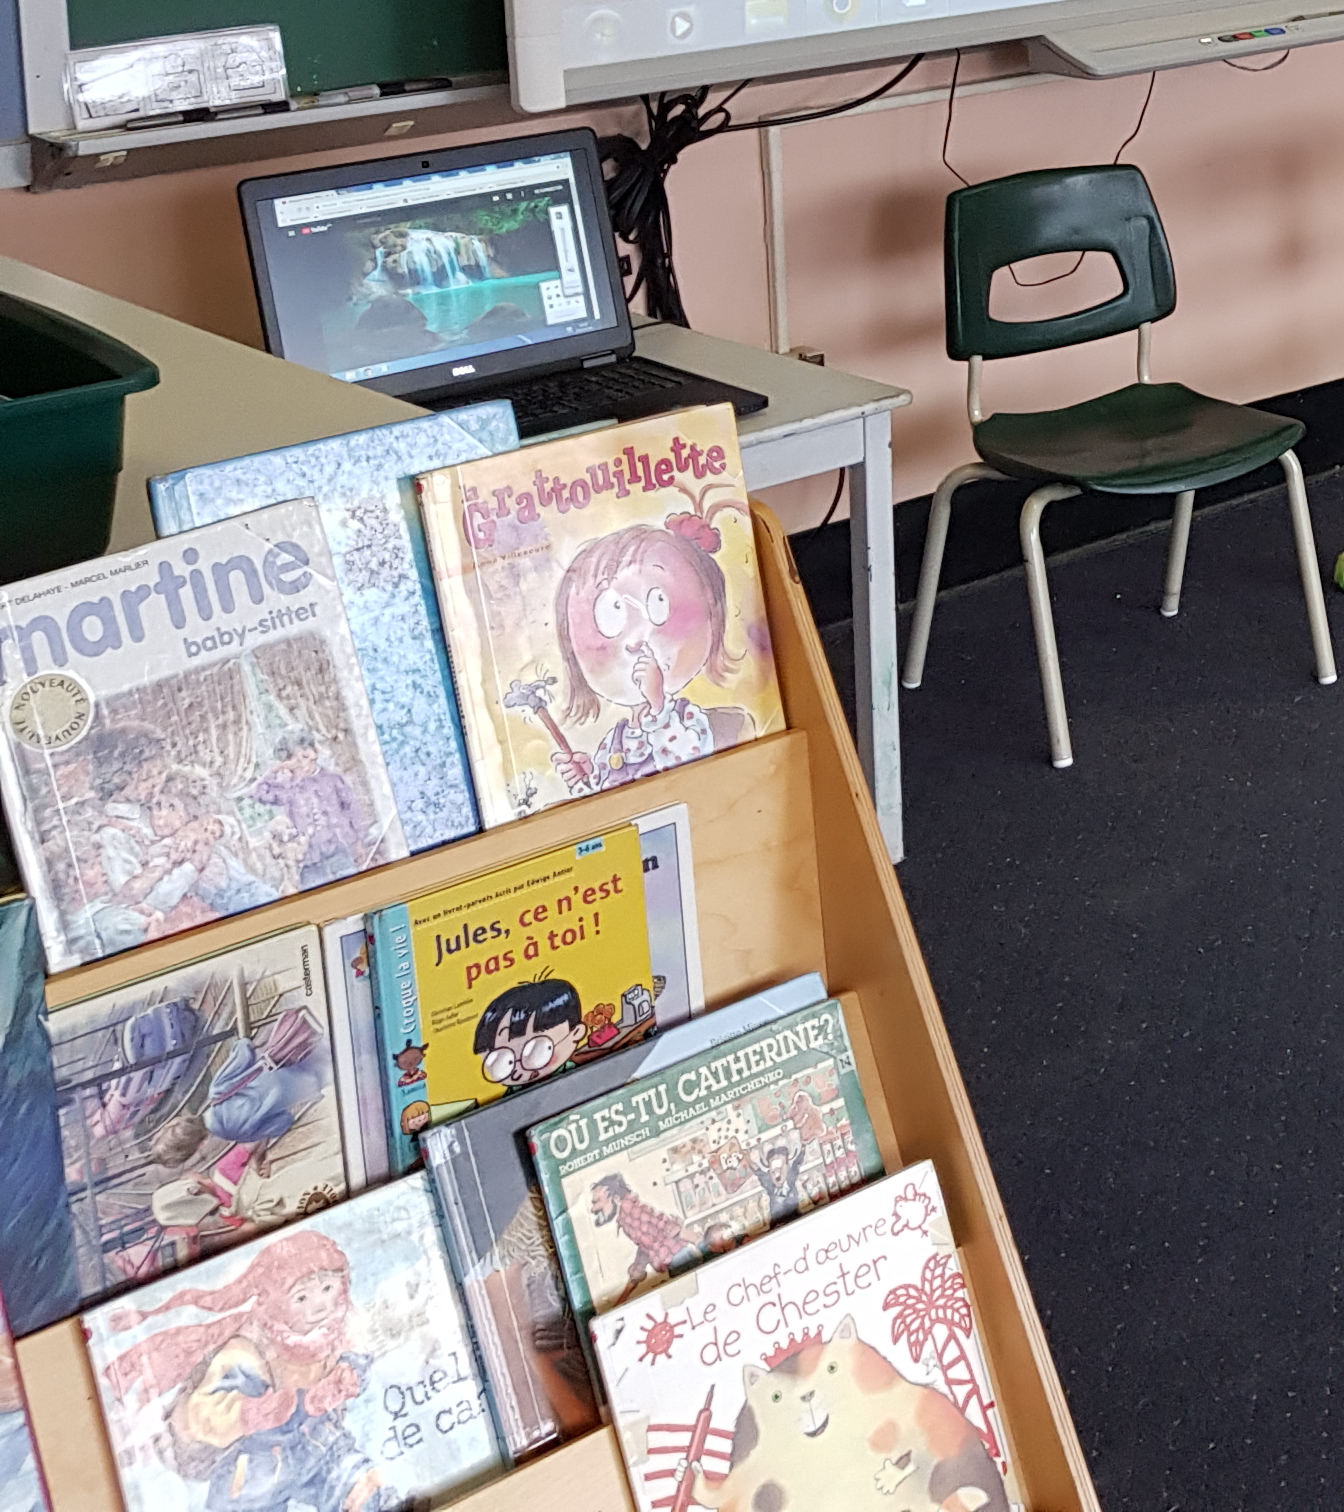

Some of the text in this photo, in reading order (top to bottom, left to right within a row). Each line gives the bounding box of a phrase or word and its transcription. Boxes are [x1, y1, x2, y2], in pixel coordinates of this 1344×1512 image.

[452, 364, 476, 377] DELL
[463, 436, 728, 550] Grattouillette
[15, 585, 62, 605] DELAHAYE
[70, 573, 109, 588] MARCEL
[109, 559, 149, 577] MARLIER
[183, 602, 318, 658] baby-sitter
[391, 935, 408, 956] vie
[434, 873, 624, 967] Jules, ce n'est
[301, 944, 314, 998] casterman
[396, 961, 410, 978] la
[465, 949, 516, 990] pas
[523, 937, 540, 961] à
[548, 917, 586, 952] toi
[400, 981, 418, 1035] Croque
[550, 1115, 590, 1160] OÙ
[597, 1082, 676, 1143] ES-TU,
[676, 1013, 835, 1105] CATHERINE?
[558, 1068, 785, 1176] ROBERT MUNSCH MICHAEL MARTCHENKO
[686, 1301, 717, 1330] Le
[699, 1255, 888, 1367] de Chester
[382, 1351, 472, 1420] Quel
[381, 1422, 423, 1461] de
